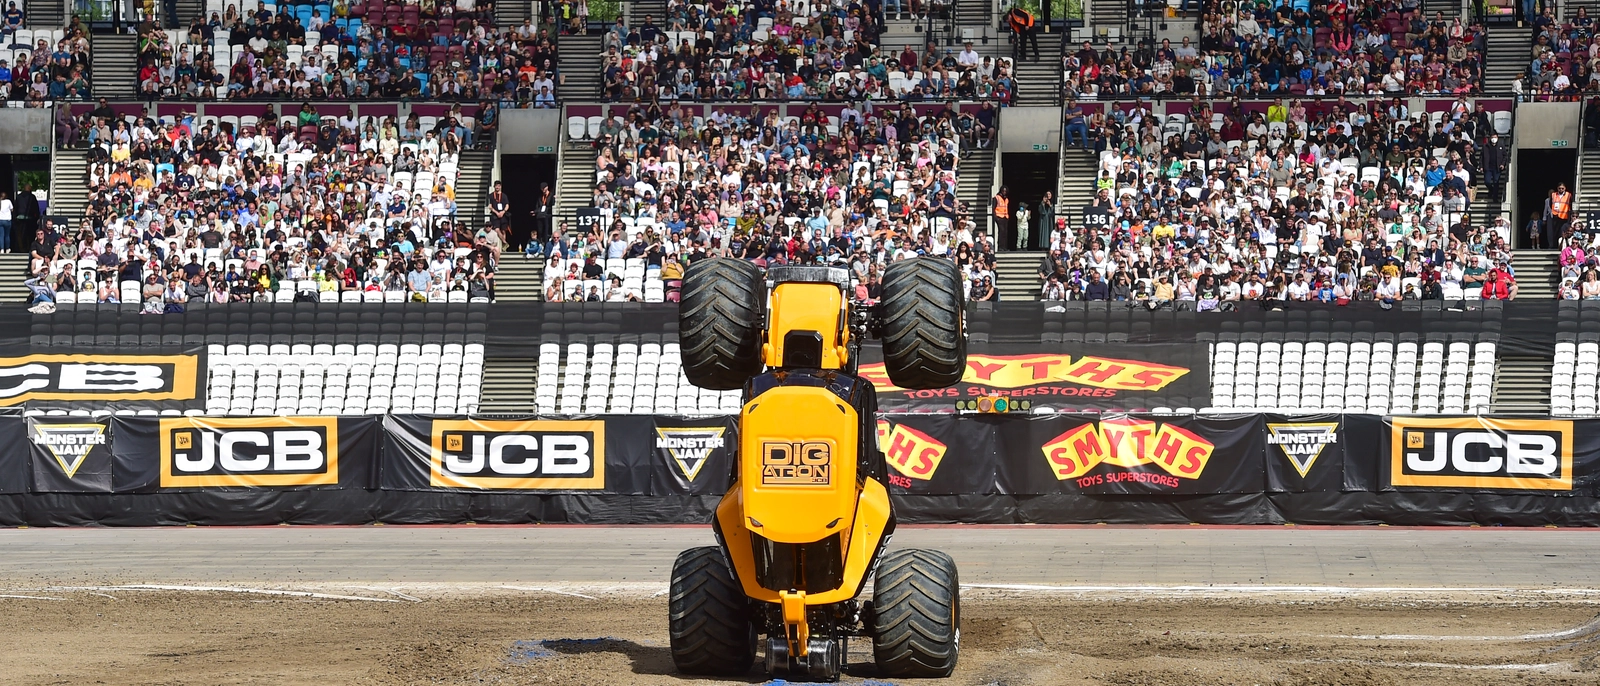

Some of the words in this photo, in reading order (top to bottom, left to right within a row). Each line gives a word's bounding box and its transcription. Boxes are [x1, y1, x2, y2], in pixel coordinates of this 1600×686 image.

[1085, 214, 1106, 225] 136
[903, 388, 960, 398] TOYS
[967, 387, 1118, 398] SUPERSTORES
[35, 433, 105, 446] MONSTER
[656, 437, 725, 450] MONSTER
[1268, 433, 1338, 445] MONSTER
[55, 444, 89, 456] JAM
[175, 430, 324, 472] JCB
[446, 434, 591, 475] JCB
[676, 447, 708, 460] JAM
[763, 442, 829, 465] DIG
[1050, 429, 1208, 475] SMYTHS
[1286, 443, 1319, 456] JAM
[1406, 432, 1558, 475] JCB
[763, 465, 829, 477] ATRON
[1077, 474, 1103, 488] TOYS
[1106, 471, 1179, 488] SUPERSTORES
